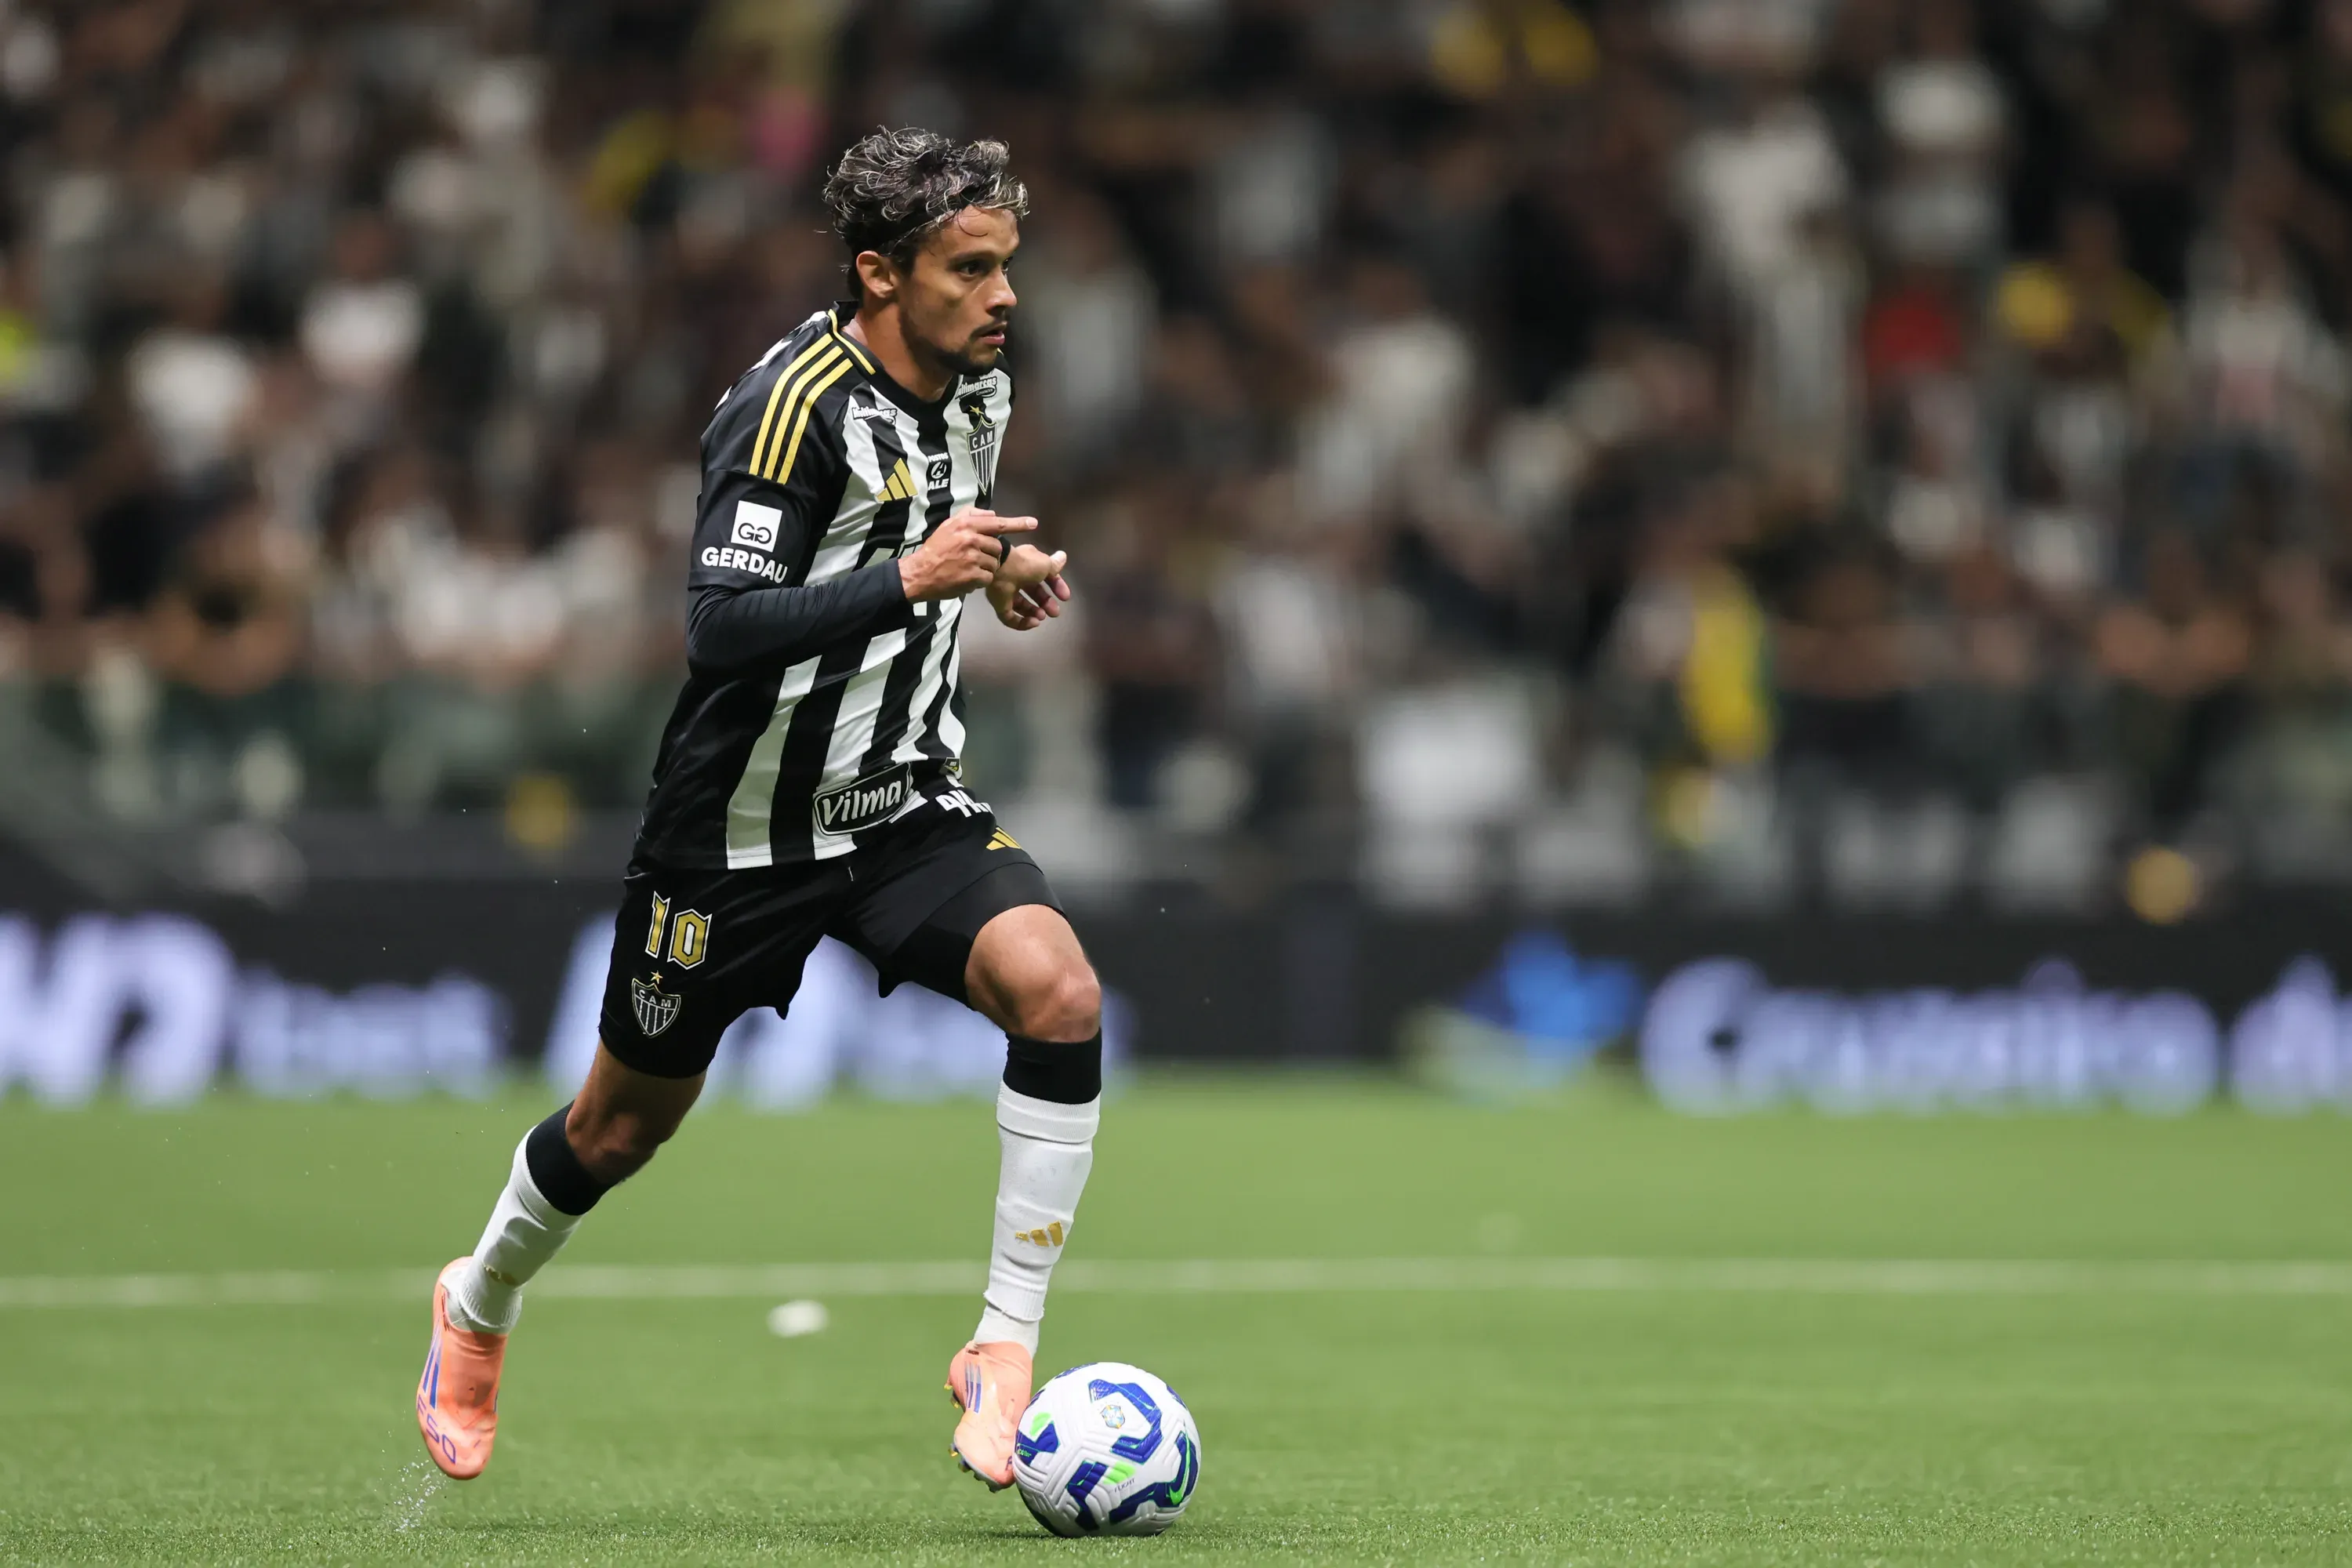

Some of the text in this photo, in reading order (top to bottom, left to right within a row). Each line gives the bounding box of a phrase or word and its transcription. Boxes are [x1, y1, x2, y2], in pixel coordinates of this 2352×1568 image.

[956, 377, 997, 395] ultimarcas
[972, 430, 993, 448] CAM
[927, 452, 949, 463] POSTOS
[927, 478, 949, 491] ALE
[701, 546, 788, 583] GERDAU
[822, 781, 902, 826] Vilma
[644, 890, 713, 971] 10
[639, 989, 671, 1007] CAM
